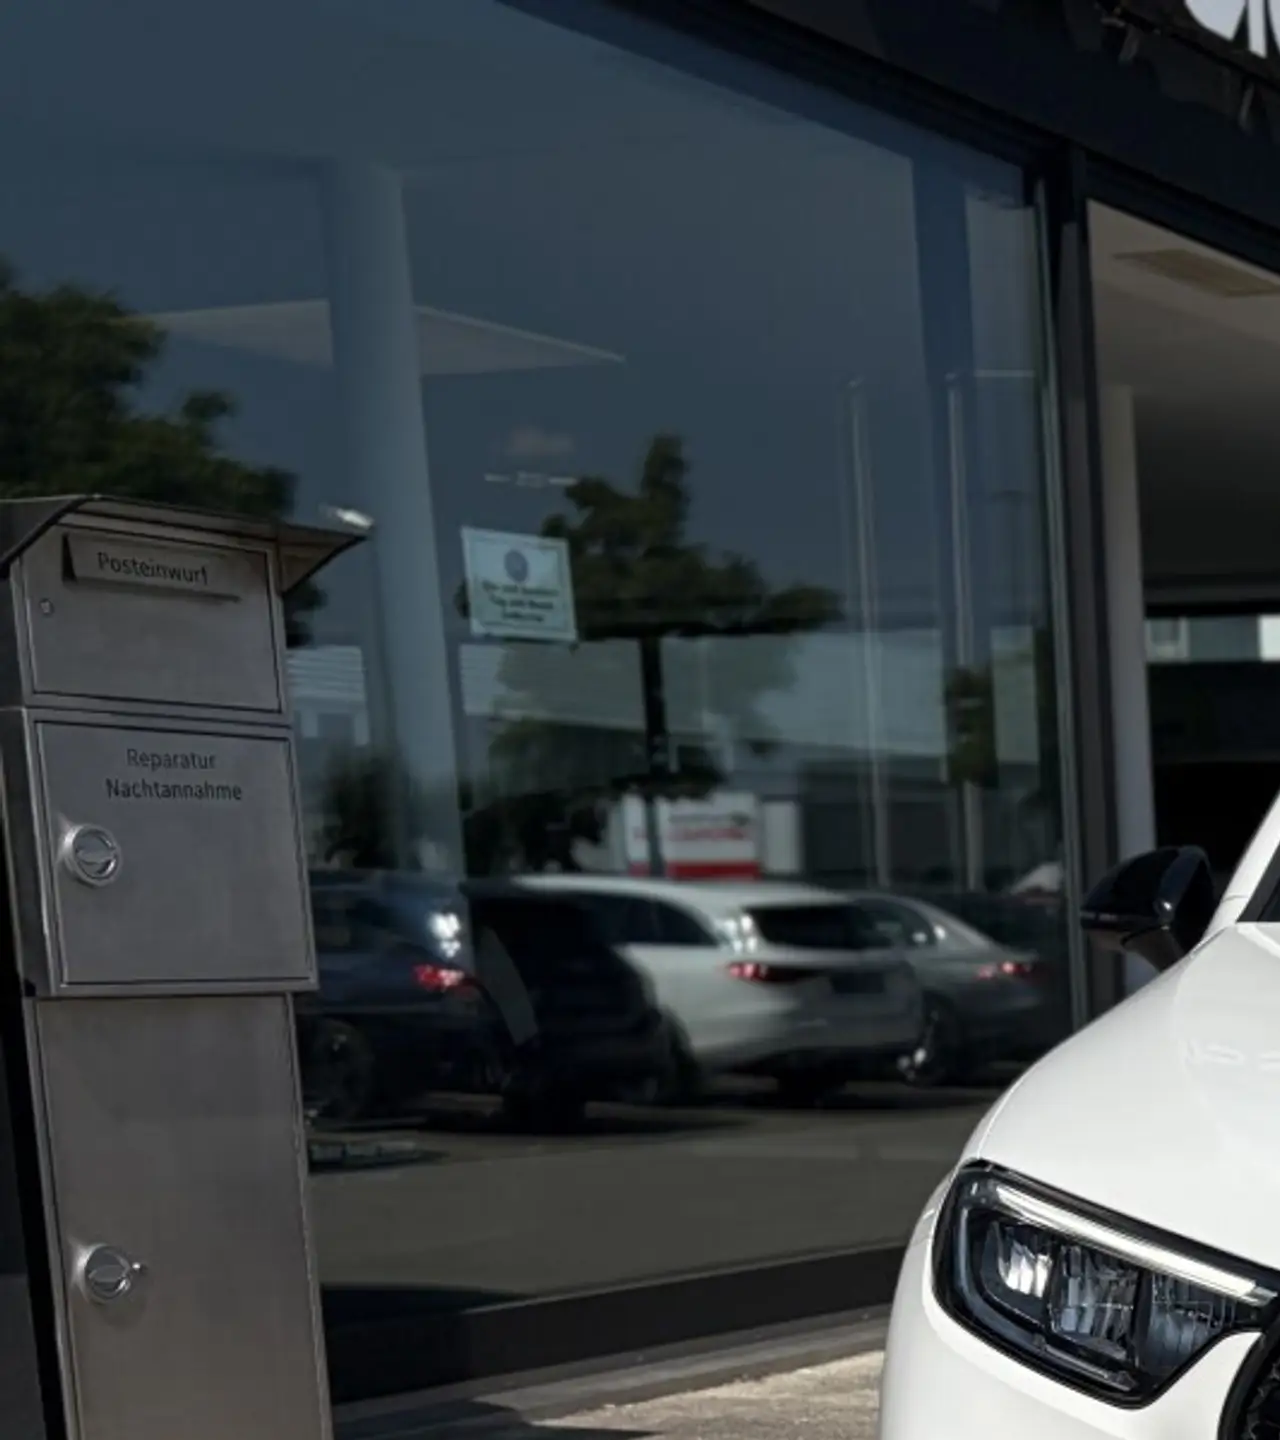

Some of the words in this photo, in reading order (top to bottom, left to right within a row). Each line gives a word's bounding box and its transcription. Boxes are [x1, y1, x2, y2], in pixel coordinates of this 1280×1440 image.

[97, 551, 209, 586] Posteinwurf
[126, 748, 217, 772] Reparatur
[105, 778, 242, 801] Nachtannahme
